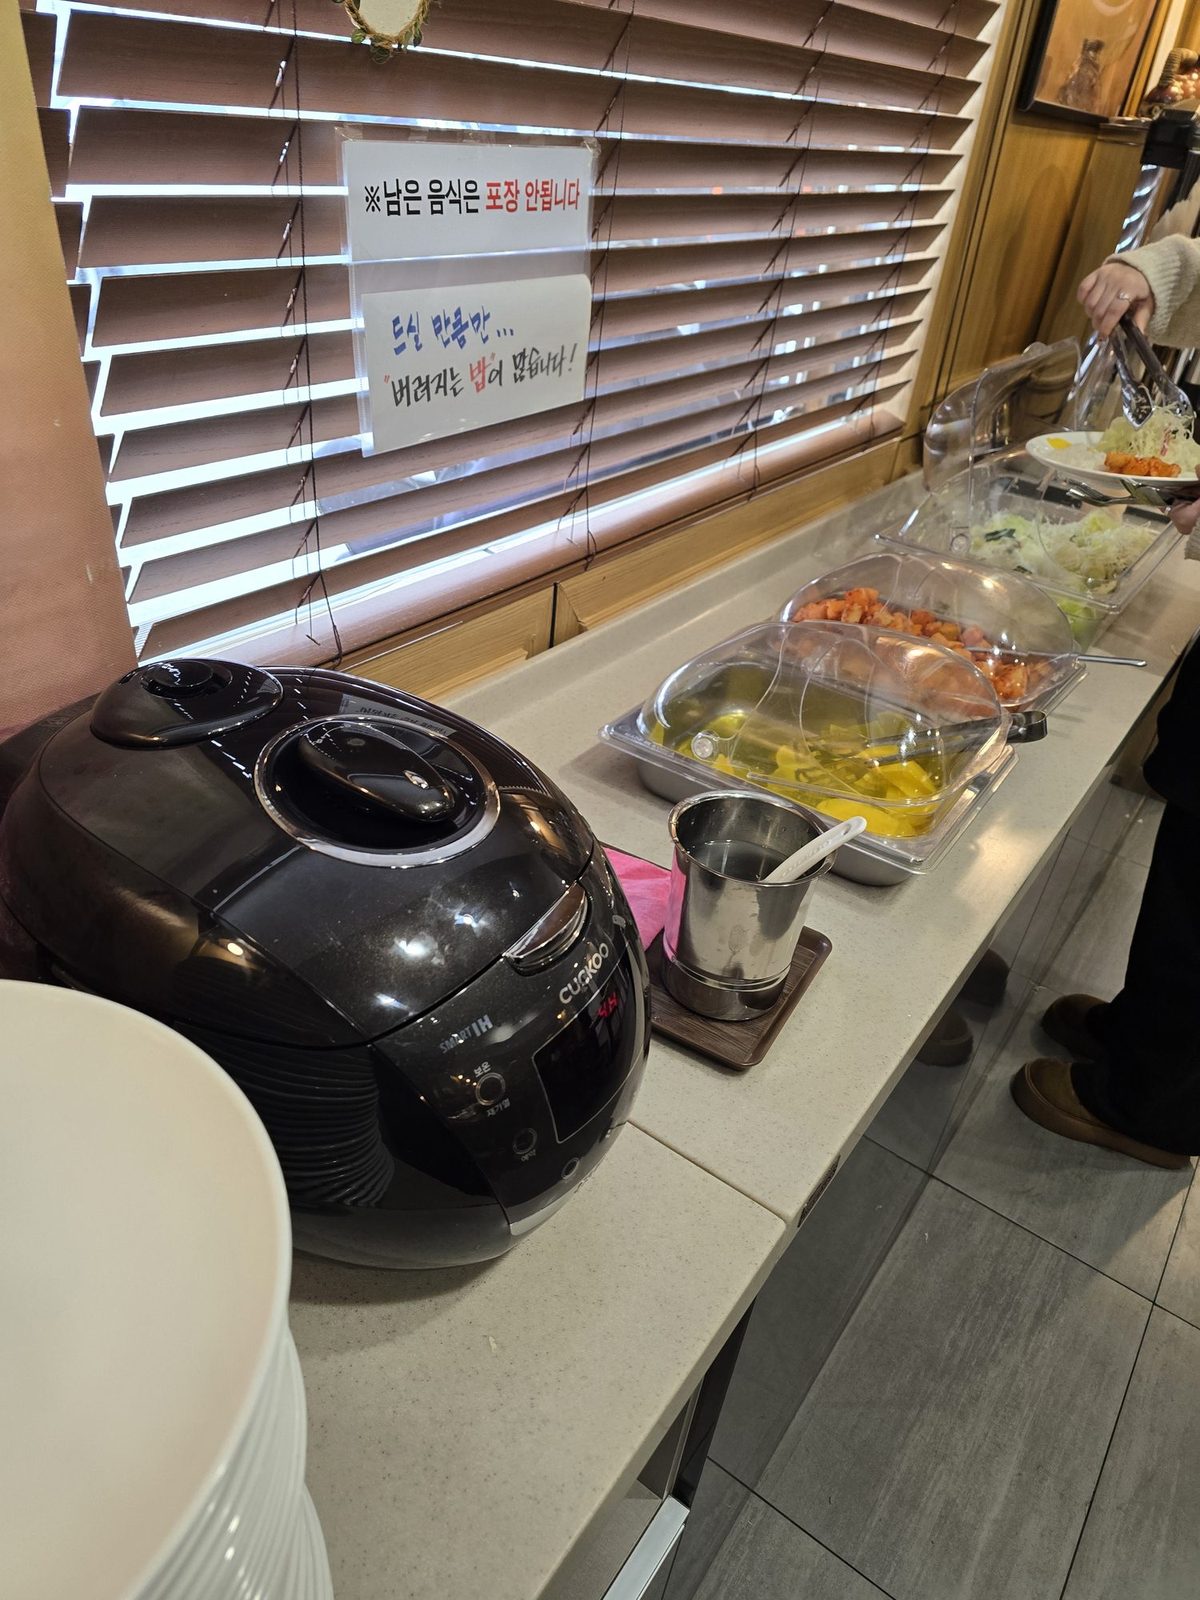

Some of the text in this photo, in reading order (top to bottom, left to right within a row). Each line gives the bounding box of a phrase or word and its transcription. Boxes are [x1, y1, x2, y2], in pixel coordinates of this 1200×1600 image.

[427, 179, 480, 215] 음식은
[485, 179, 519, 213] 포장
[525, 178, 580, 212] 안됩니다
[392, 312, 422, 355] 드실
[559, 943, 609, 1004] CUCKOO
[440, 1014, 494, 1053] SMART IH
[474, 1061, 492, 1077] 보온
